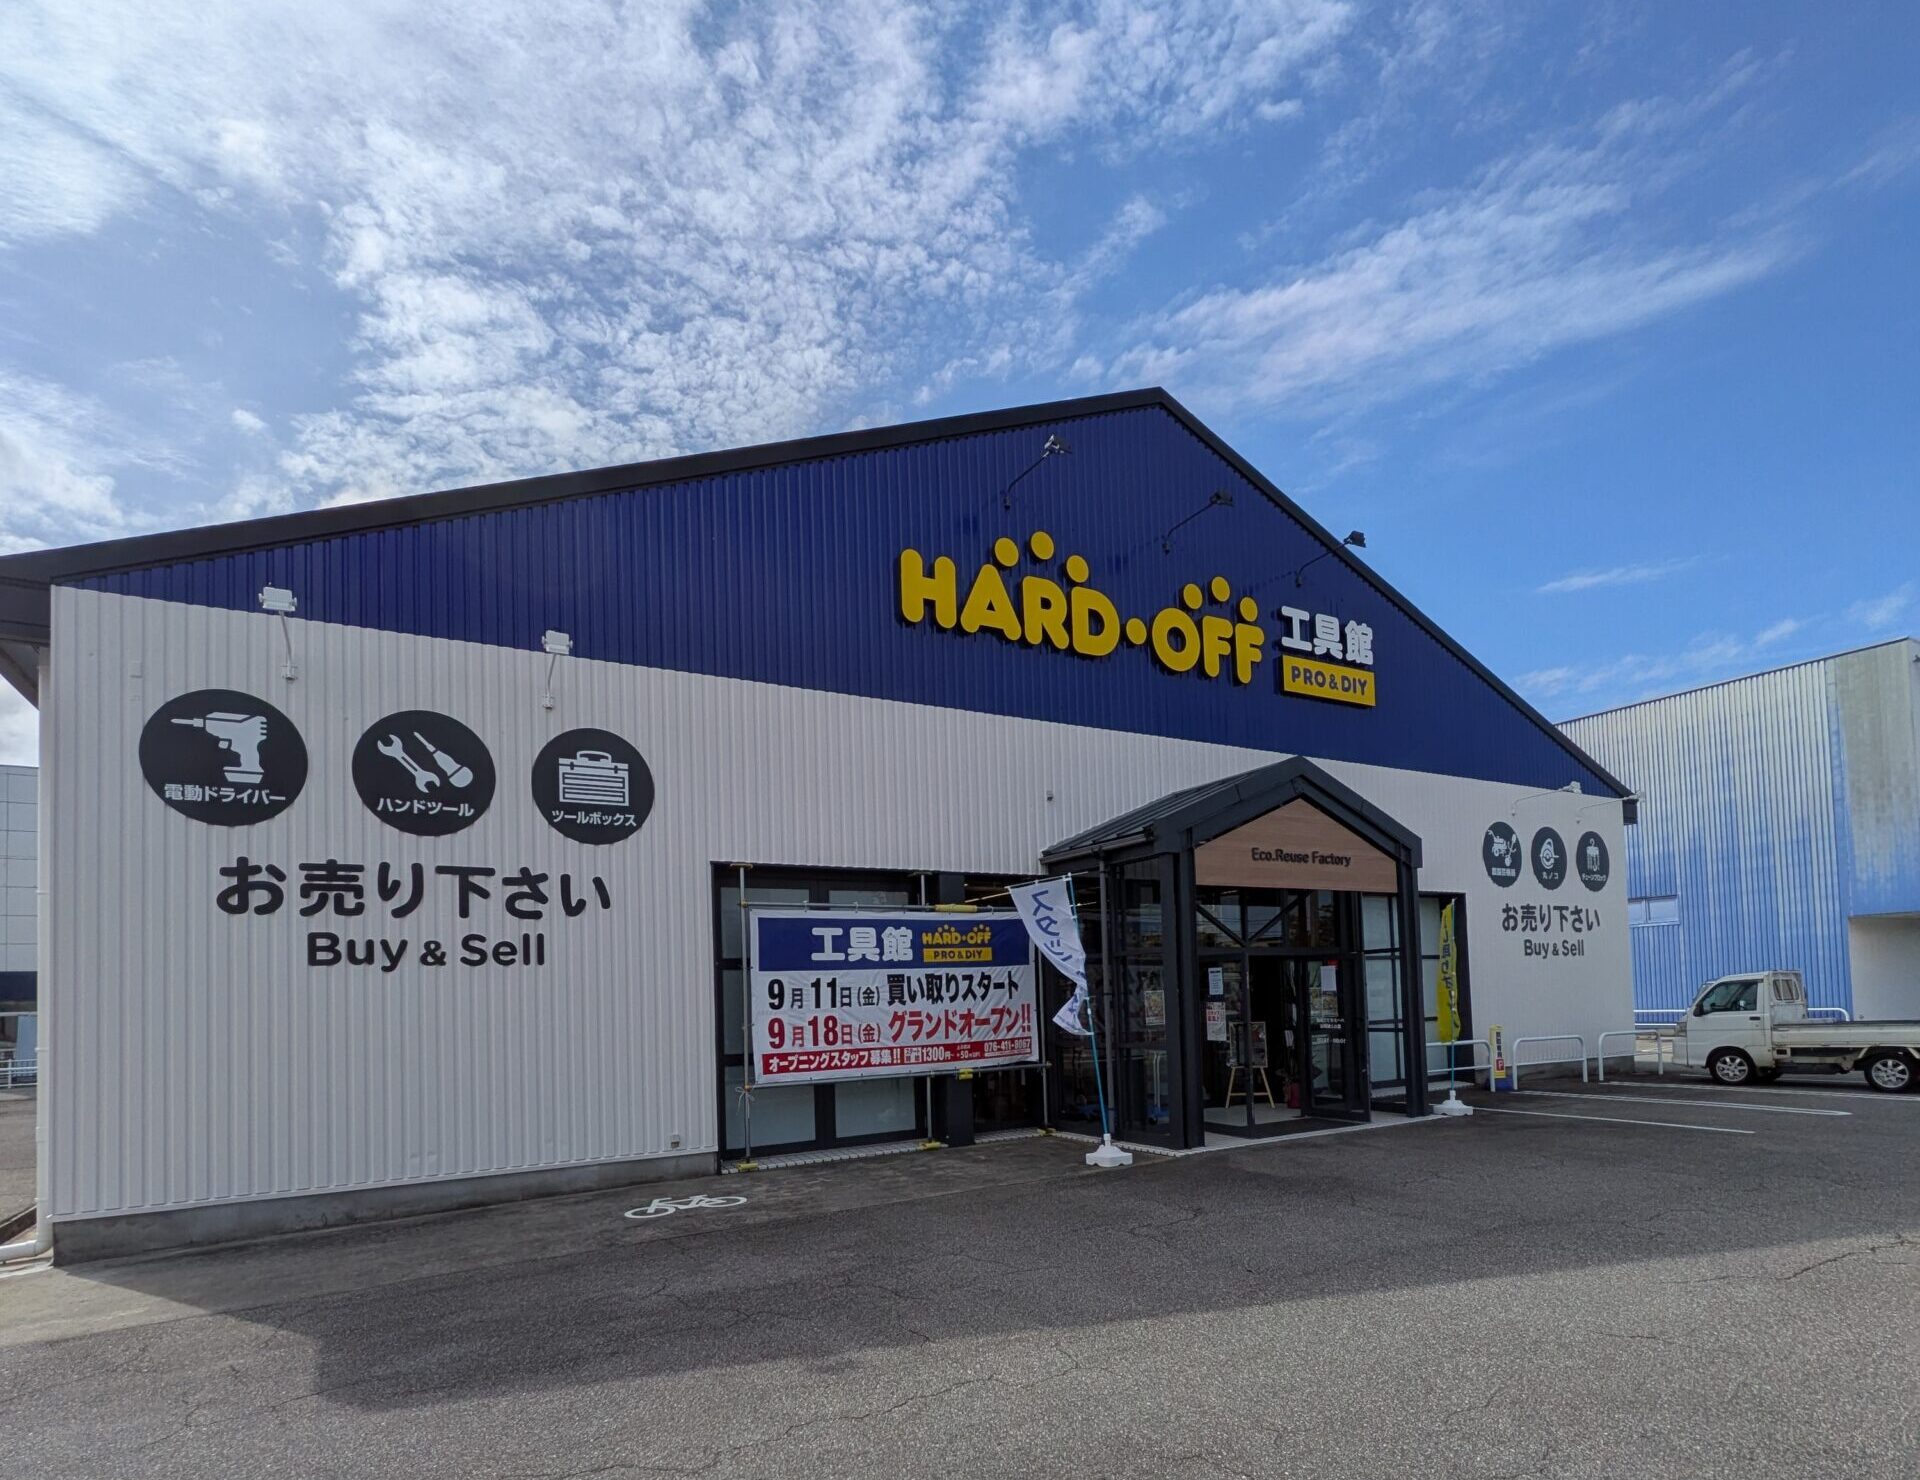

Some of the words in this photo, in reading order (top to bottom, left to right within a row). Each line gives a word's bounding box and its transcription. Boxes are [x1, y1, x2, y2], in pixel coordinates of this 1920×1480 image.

[1281, 605, 1375, 667] 工具館
[164, 782, 286, 806] 電動ドライバー
[377, 797, 475, 818] ハンドツール
[552, 809, 637, 828] ツールボックス
[1311, 851, 1351, 867] Factory
[216, 856, 611, 919] お売り下さい
[1502, 903, 1600, 933] お売り下さい
[307, 932, 408, 972] Buy
[419, 940, 447, 967] &
[460, 933, 545, 967] Sell
[811, 926, 914, 962] 工具館
[1524, 939, 1549, 959] Buy
[1552, 942, 1559, 956] &
[1562, 939, 1584, 956] Sell
[887, 970, 1019, 1007] 買い取りスタート
[888, 1003, 1031, 1044] グランドオープン!!
[769, 1048, 901, 1073] オープニングスタッフ募集!!
